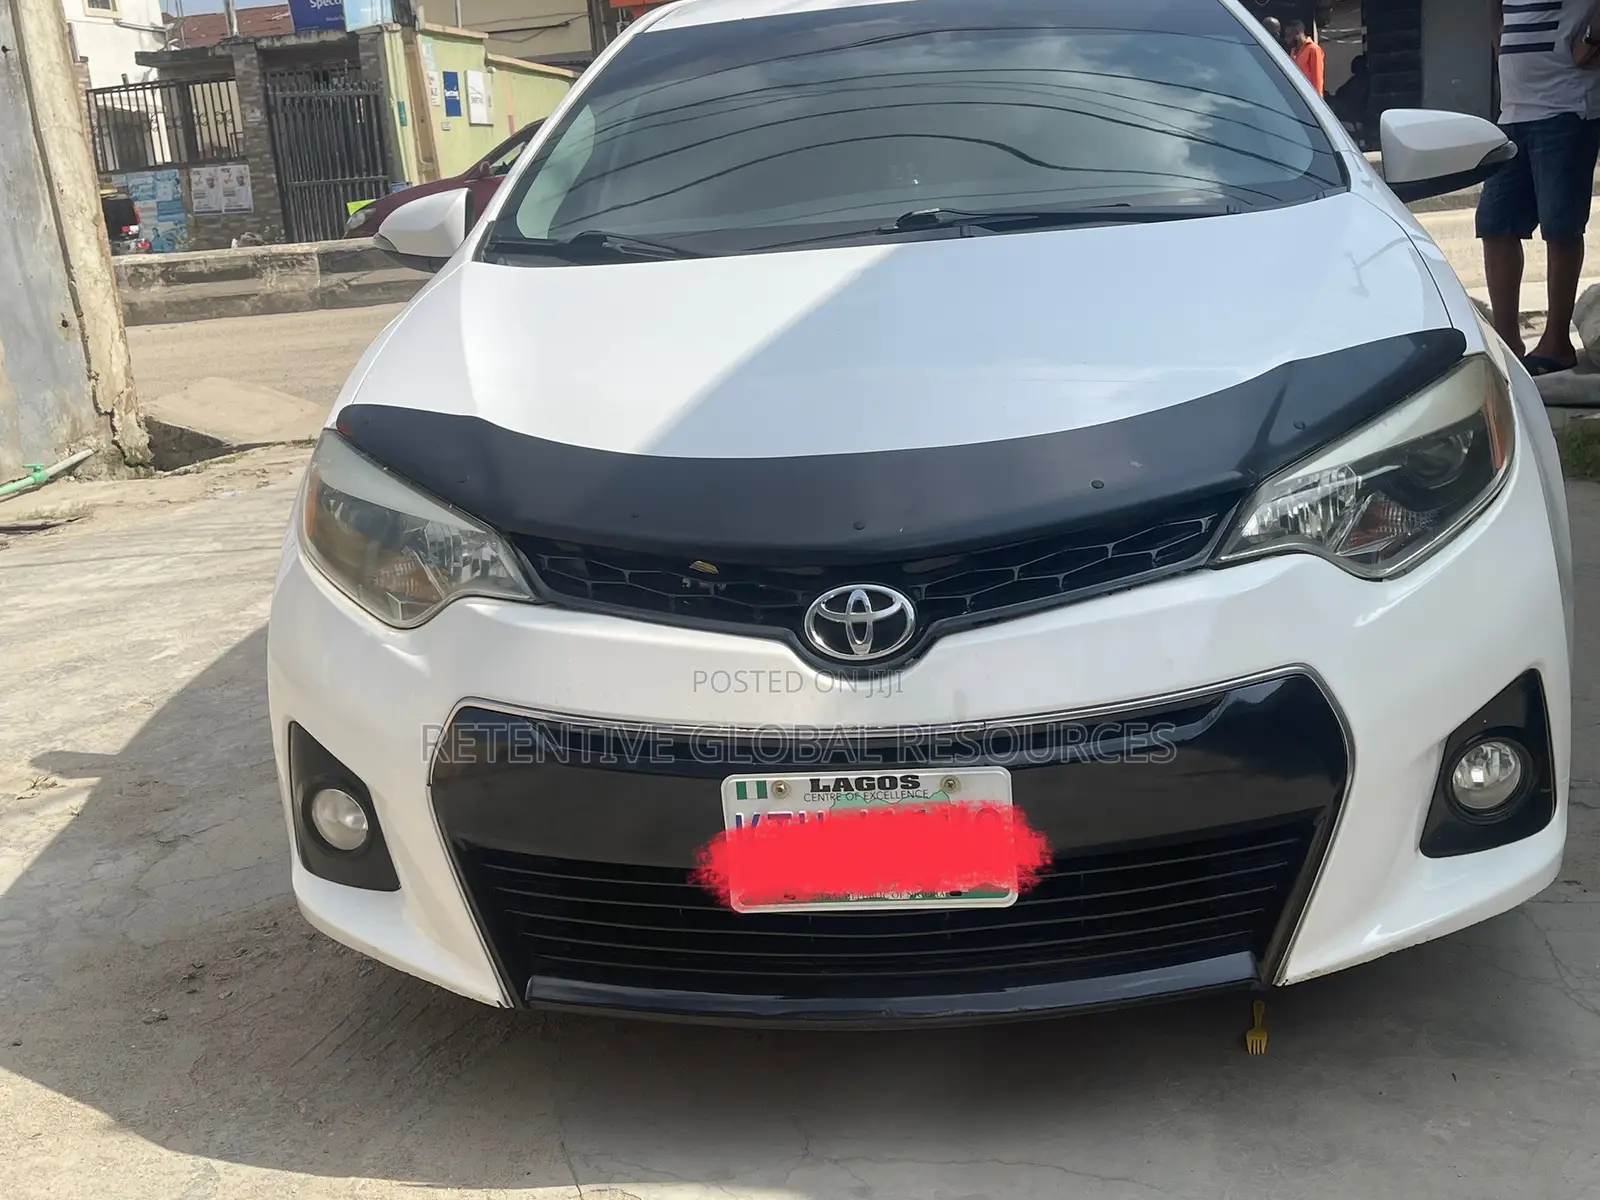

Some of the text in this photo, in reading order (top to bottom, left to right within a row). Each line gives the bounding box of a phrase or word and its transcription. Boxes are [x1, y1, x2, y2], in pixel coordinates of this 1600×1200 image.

[809, 775, 920, 792] LAGOS
[803, 789, 928, 802] CENTRE OF EXCELLENCE
